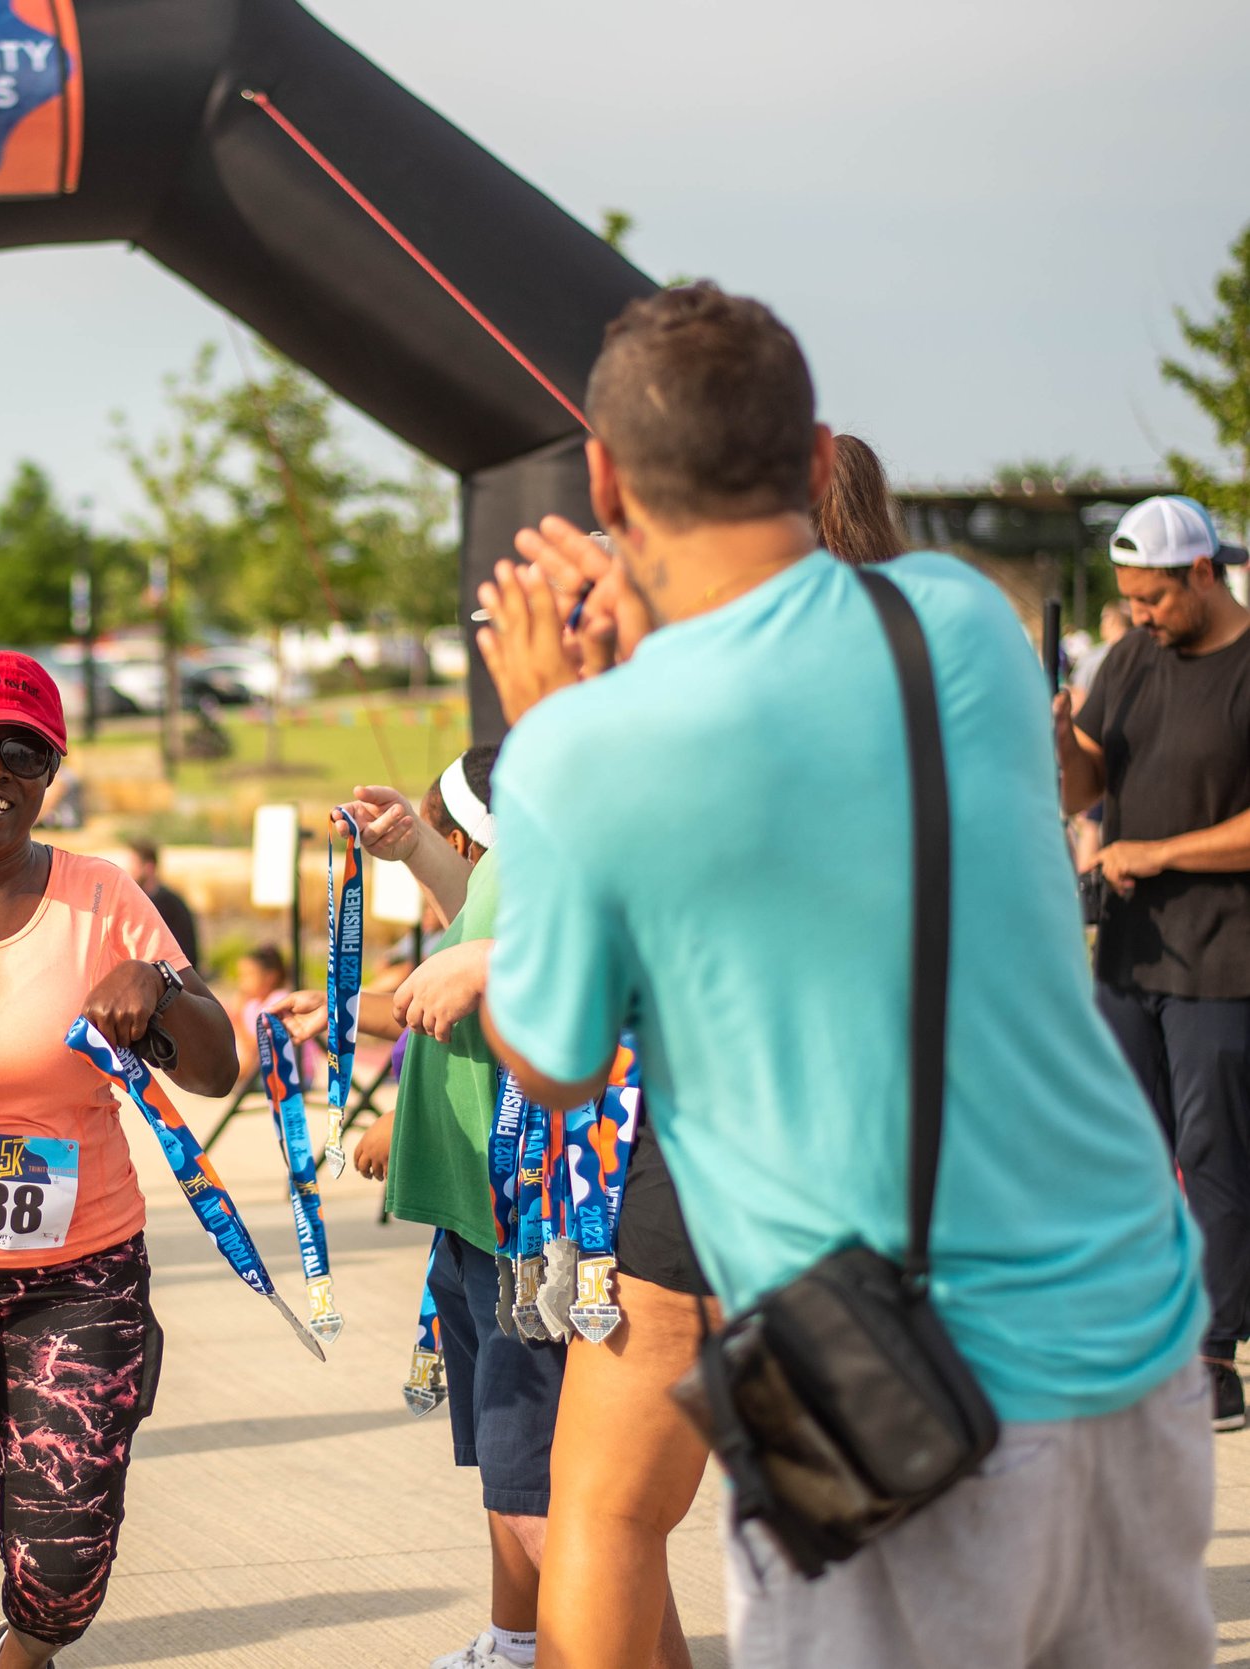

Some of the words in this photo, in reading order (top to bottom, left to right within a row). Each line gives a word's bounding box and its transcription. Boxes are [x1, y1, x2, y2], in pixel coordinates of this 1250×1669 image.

[341, 886, 361, 953] FINISHER
[339, 956, 360, 990] 2023
[328, 1017, 338, 1049] DAY
[0, 1139, 24, 1176] 5K
[494, 1137, 516, 1174] 2023
[524, 1130, 545, 1161] DAY
[520, 1166, 543, 1187] 5K
[196, 1195, 230, 1231] DAY
[290, 1195, 313, 1243] TRINITY
[578, 1204, 606, 1249] 2023
[218, 1225, 252, 1270] TRAIL
[579, 1260, 610, 1304] 5K
